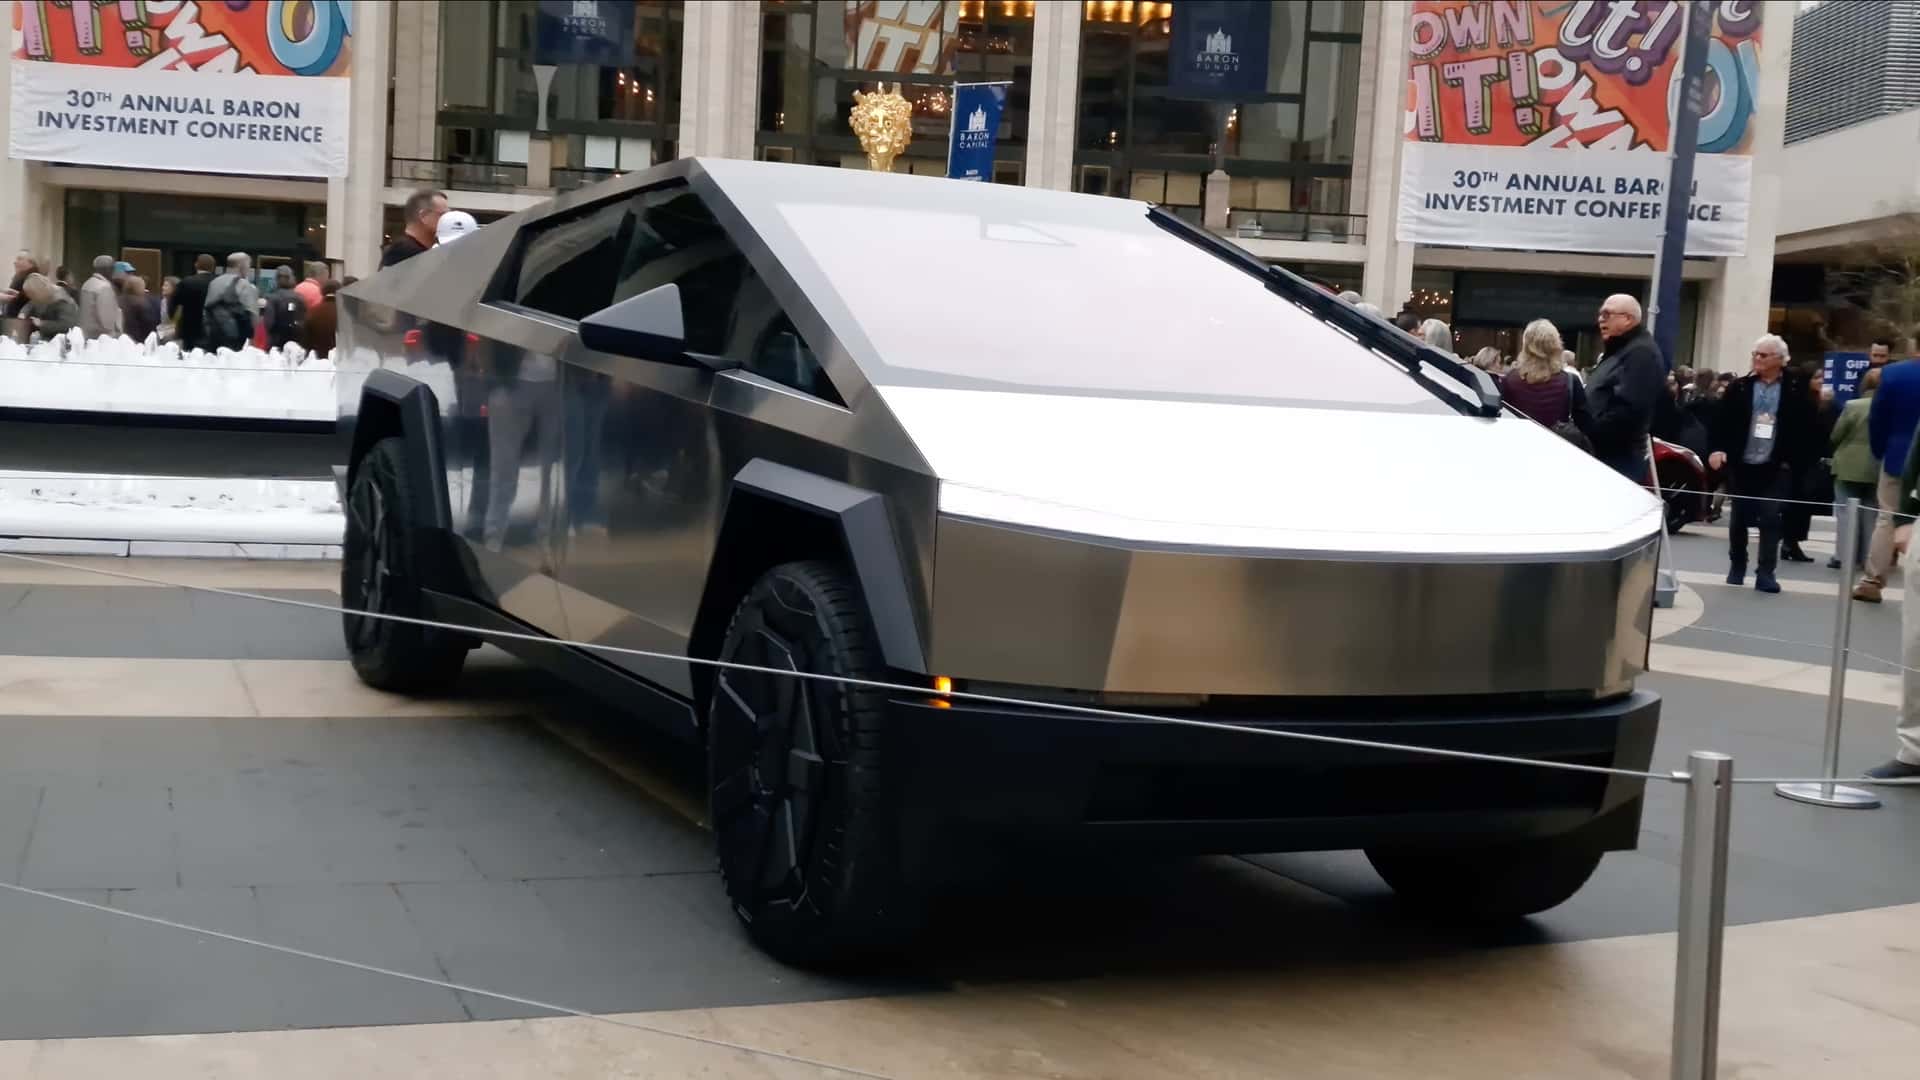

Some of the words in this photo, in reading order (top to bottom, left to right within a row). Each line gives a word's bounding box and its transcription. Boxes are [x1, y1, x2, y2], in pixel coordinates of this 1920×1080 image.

[1409, 1, 1533, 59] OWN
[1197, 54, 1239, 63] BARON
[66, 89, 112, 108] 30TH
[120, 94, 216, 115] ANNUAL
[223, 100, 300, 119] BARON
[1412, 51, 1542, 142] IT!
[37, 110, 178, 136] INVESTMENT
[186, 121, 323, 143] CONFERENCE
[960, 132, 989, 142] BARON
[959, 141, 988, 149] CAPITAL
[1452, 171, 1499, 189] 30TH
[1505, 174, 1606, 193] ANNUAL
[1614, 177, 1697, 196] BAR
[1424, 192, 1568, 216] INVESTMENT
[1574, 200, 1723, 222] CONFERCE
